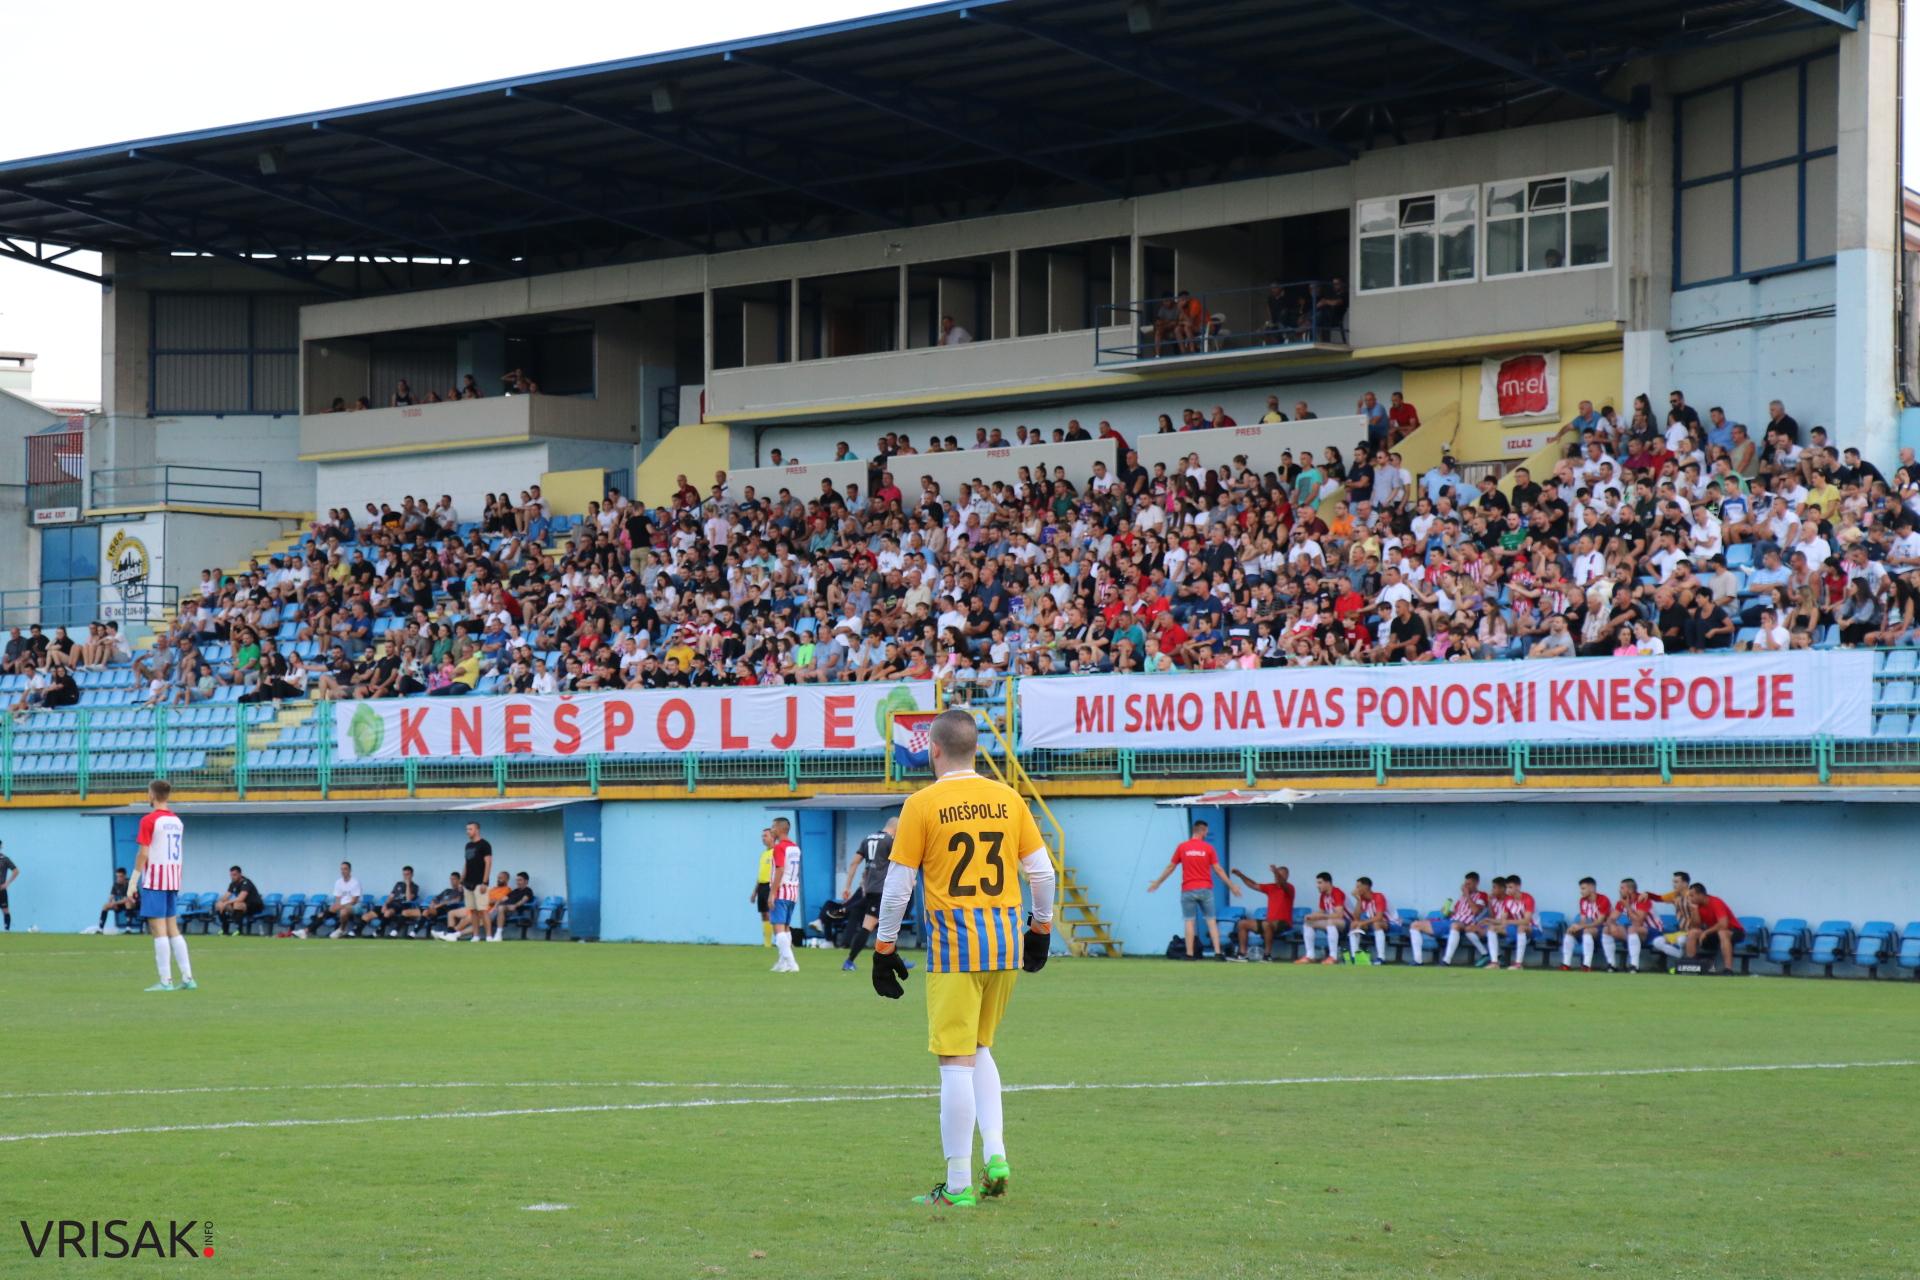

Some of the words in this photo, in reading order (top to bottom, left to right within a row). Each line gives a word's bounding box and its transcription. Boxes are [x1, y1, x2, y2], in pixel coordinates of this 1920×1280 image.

[1235, 427, 1262, 436] PRESS
[986, 449, 1010, 457] PRESS
[1508, 439, 1532, 449] IZLAZ
[785, 466, 807, 475] PRESS
[112, 563, 143, 585] Gradski
[1075, 695, 1115, 733] MI
[1124, 692, 1203, 733] SMO
[1214, 690, 1265, 730] NA
[1273, 687, 1345, 728] VAS
[1356, 681, 1536, 727] PONOSNI
[1551, 668, 1794, 721] KNEŠPOLJE
[400, 694, 855, 756] KNEŠPOLJE
[939, 801, 1008, 824] KNEŠPOLJE
[167, 833, 181, 861] 13
[948, 831, 1004, 896] 23
